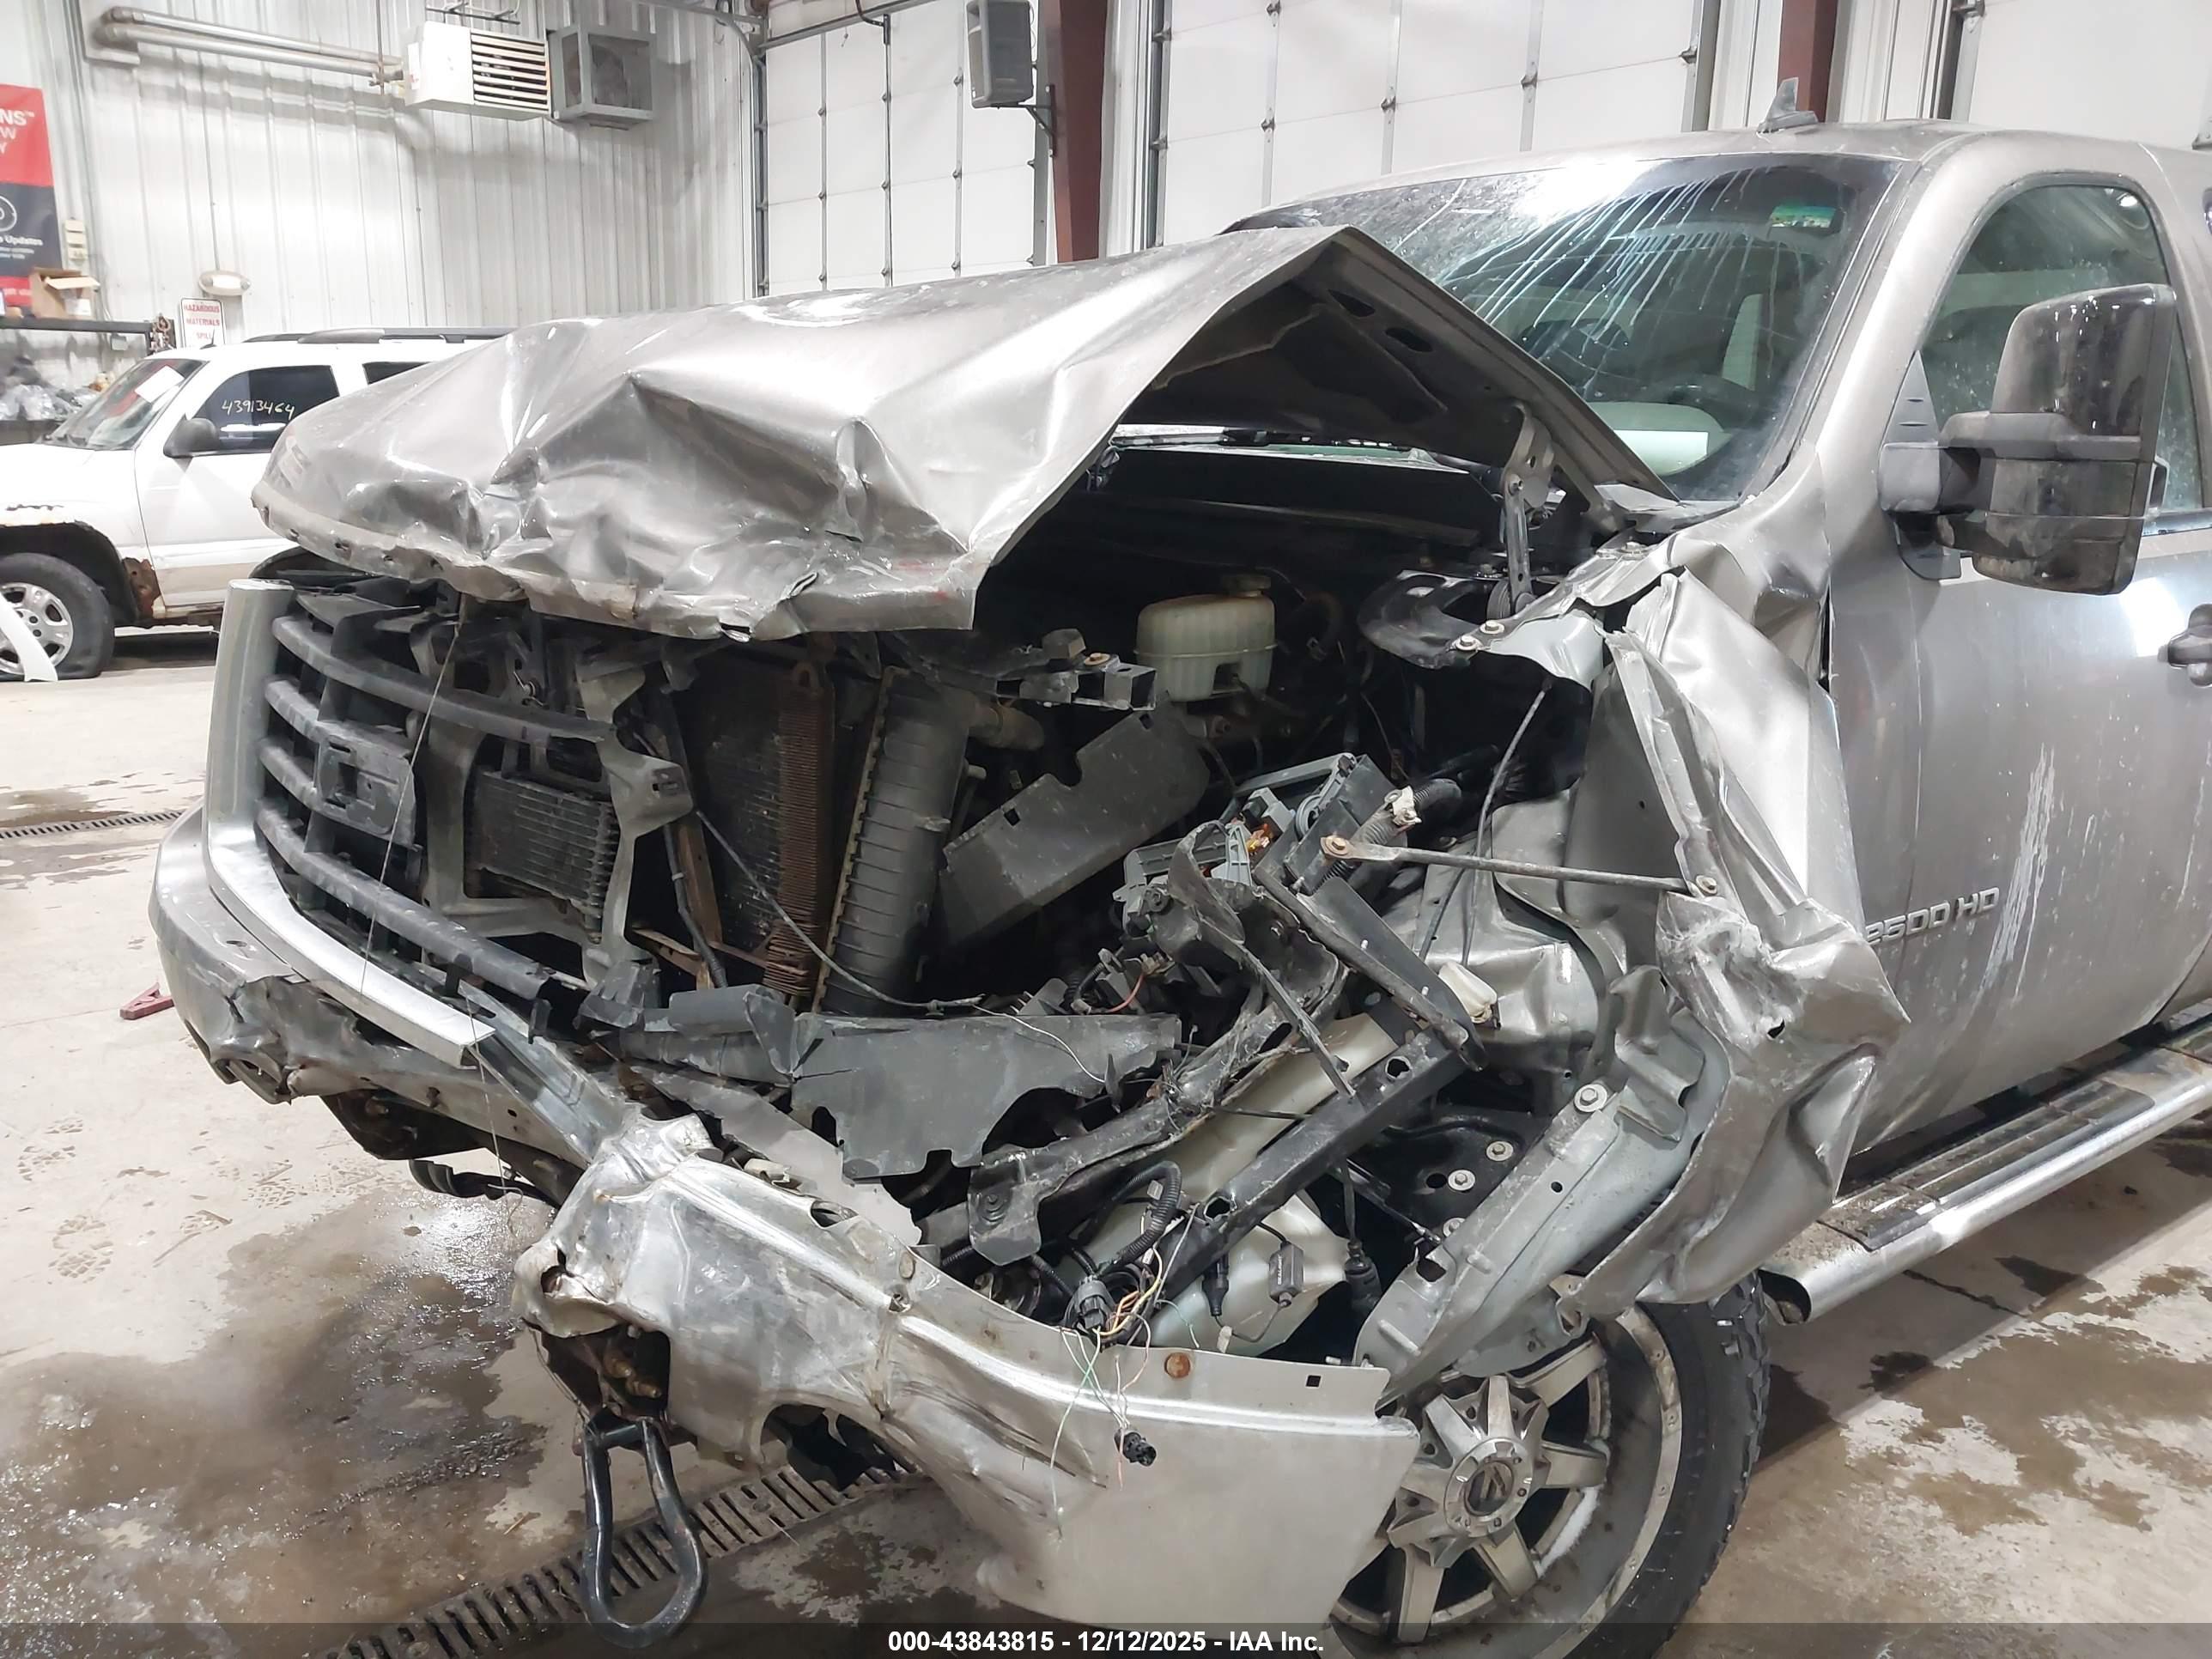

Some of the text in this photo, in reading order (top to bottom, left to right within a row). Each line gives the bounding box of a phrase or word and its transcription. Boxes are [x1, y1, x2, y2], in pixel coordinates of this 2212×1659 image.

[185, 318, 221, 326] MATERIALS
[222, 399, 295, 421] 43913464
[1865, 887, 2000, 945] 2500 HD
